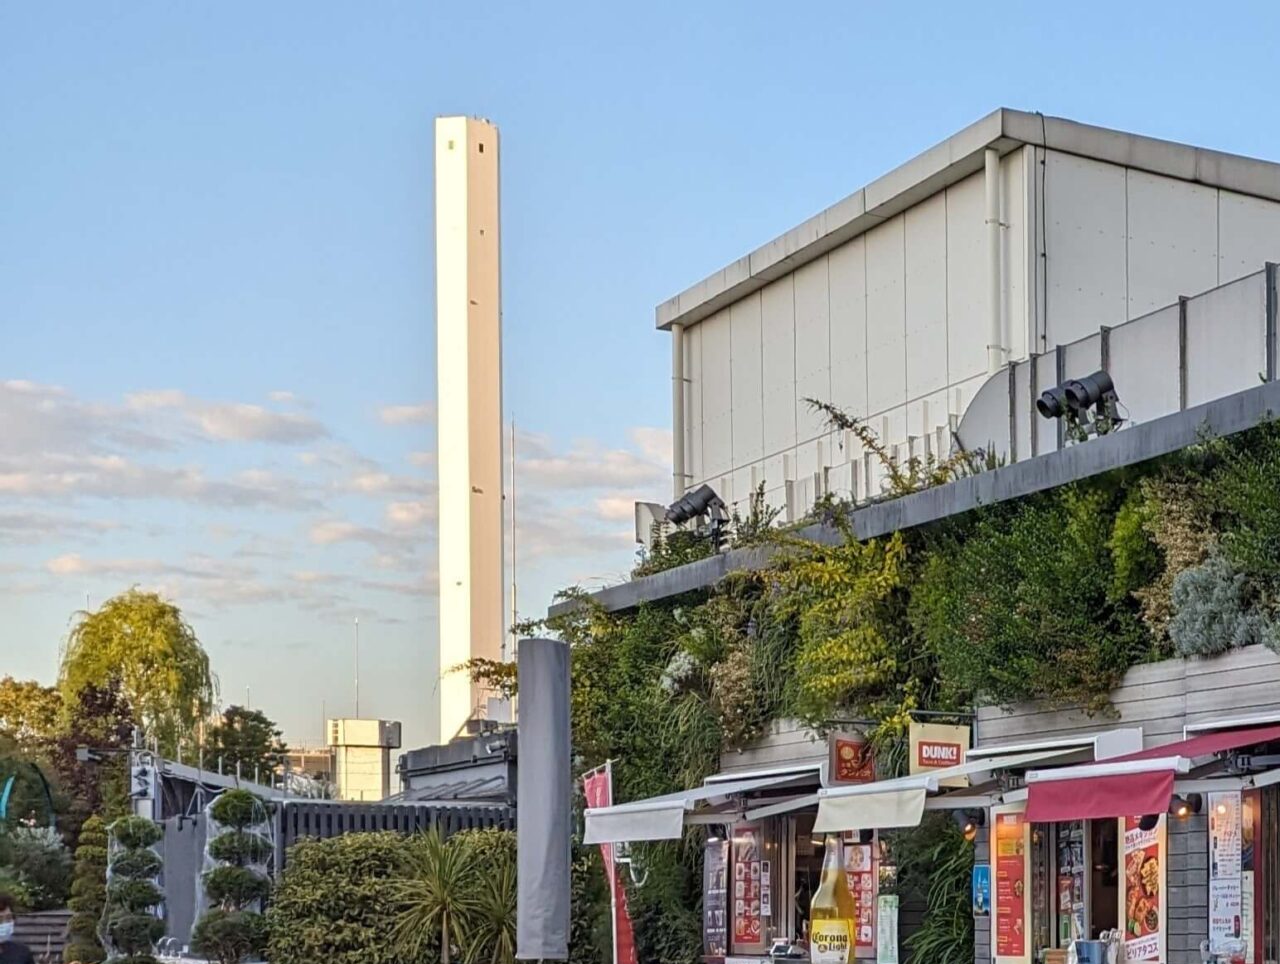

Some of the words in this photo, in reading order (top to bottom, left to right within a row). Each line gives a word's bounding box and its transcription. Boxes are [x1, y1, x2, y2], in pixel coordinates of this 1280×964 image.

[922, 745, 957, 759] DUNK!
[812, 931, 848, 944] Corona
[828, 943, 847, 951] Light
